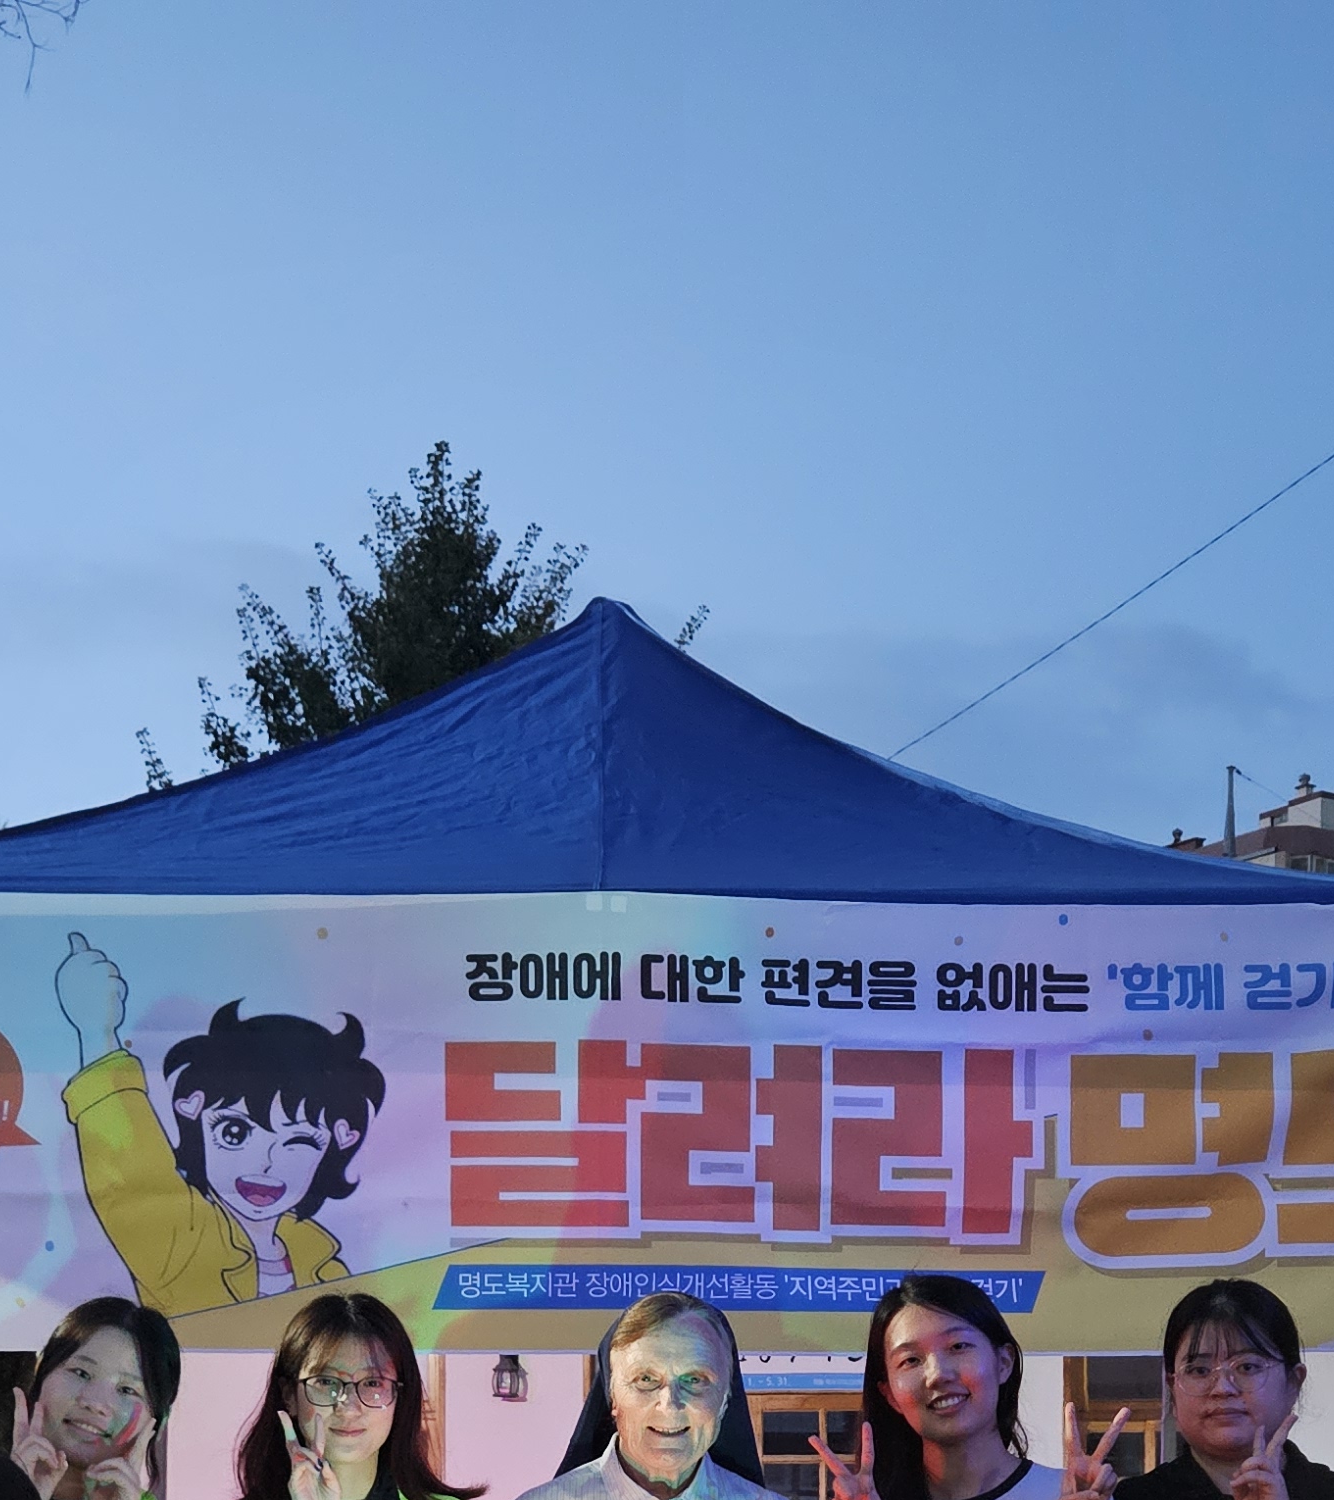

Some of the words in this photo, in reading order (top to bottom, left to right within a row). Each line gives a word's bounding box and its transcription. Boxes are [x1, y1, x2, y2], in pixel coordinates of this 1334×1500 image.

[465, 951, 622, 1002] 장애에
[640, 953, 746, 1004] 대한
[760, 957, 918, 1012] 편견을
[935, 961, 1091, 1013] 없애는
[1107, 962, 1225, 1012] '함께
[443, 1037, 1039, 1240] 달려라
[457, 1271, 579, 1300] 명도복지관
